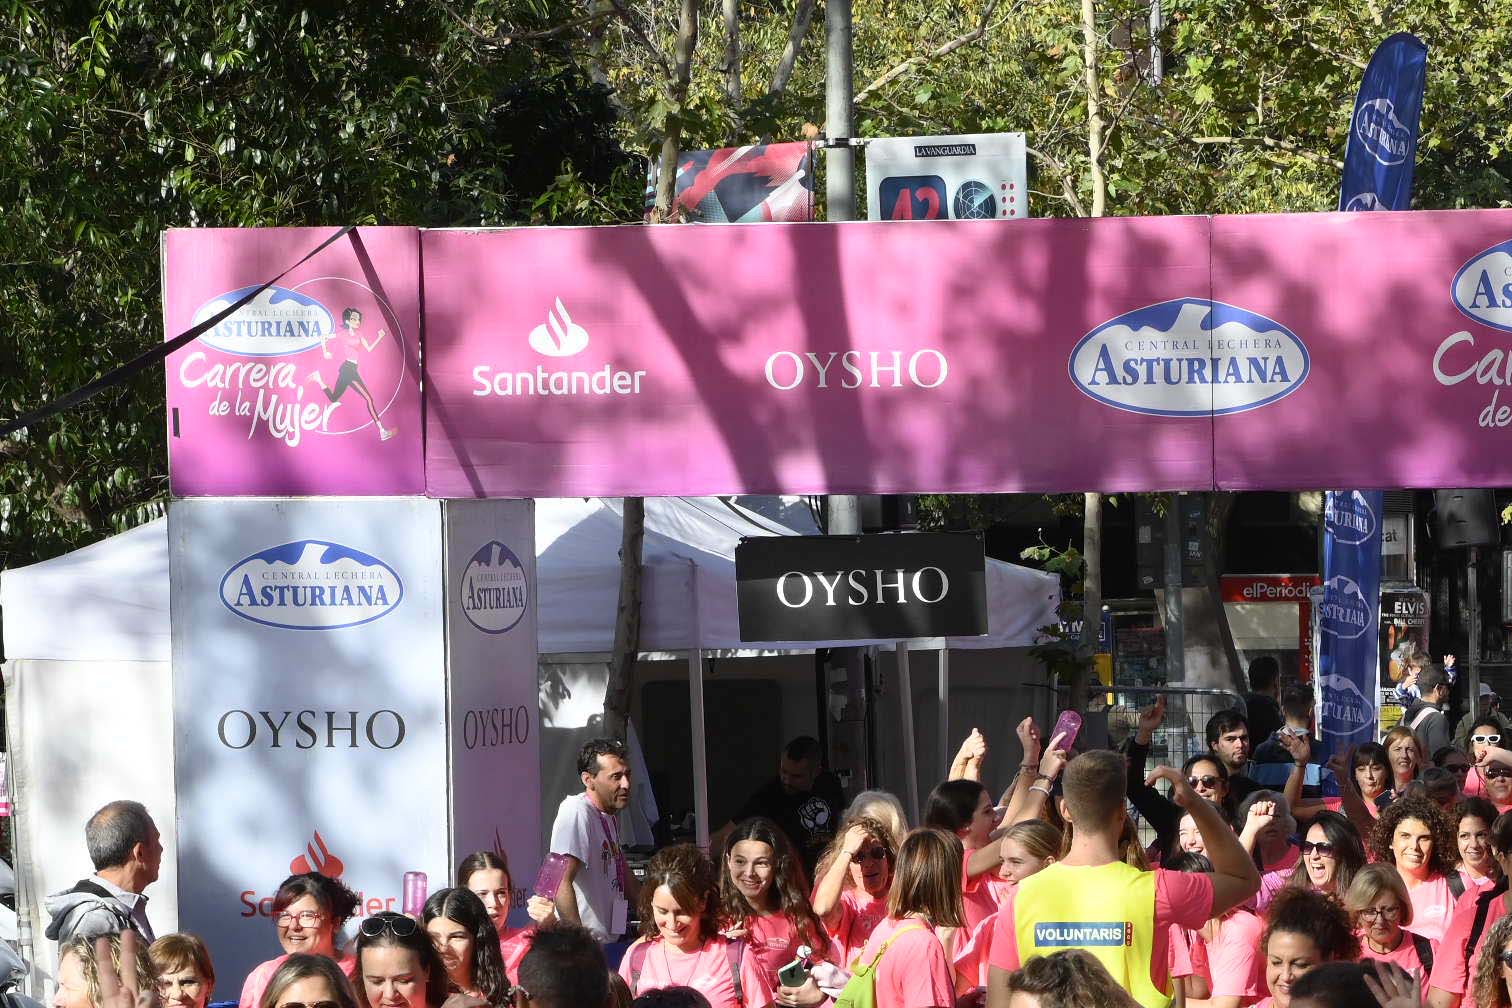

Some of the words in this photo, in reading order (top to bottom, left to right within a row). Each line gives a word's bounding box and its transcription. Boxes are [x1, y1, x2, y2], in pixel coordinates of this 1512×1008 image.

[1124, 339, 1200, 351] CENTRAL
[1208, 336, 1283, 349] LECHERA
[179, 351, 297, 389] Carrera
[473, 363, 647, 397] Santander
[764, 349, 949, 390] OYSHO
[1087, 343, 1291, 386] ASTURIANA
[208, 390, 230, 416] de
[235, 389, 250, 416] la
[248, 386, 342, 448] Mujer
[1478, 389, 1512, 428] de
[234, 574, 389, 607] ASTURIANA
[262, 571, 320, 580] CENTRAL
[326, 569, 384, 580] LECHERA
[465, 575, 524, 611] ASTURIANA
[776, 566, 949, 609] OYSHO
[1394, 602, 1425, 614] ELVIS
[217, 709, 406, 750] OYSHO
[464, 705, 530, 750] OYSHO
[1036, 928, 1122, 941] VOLUNTARIS
